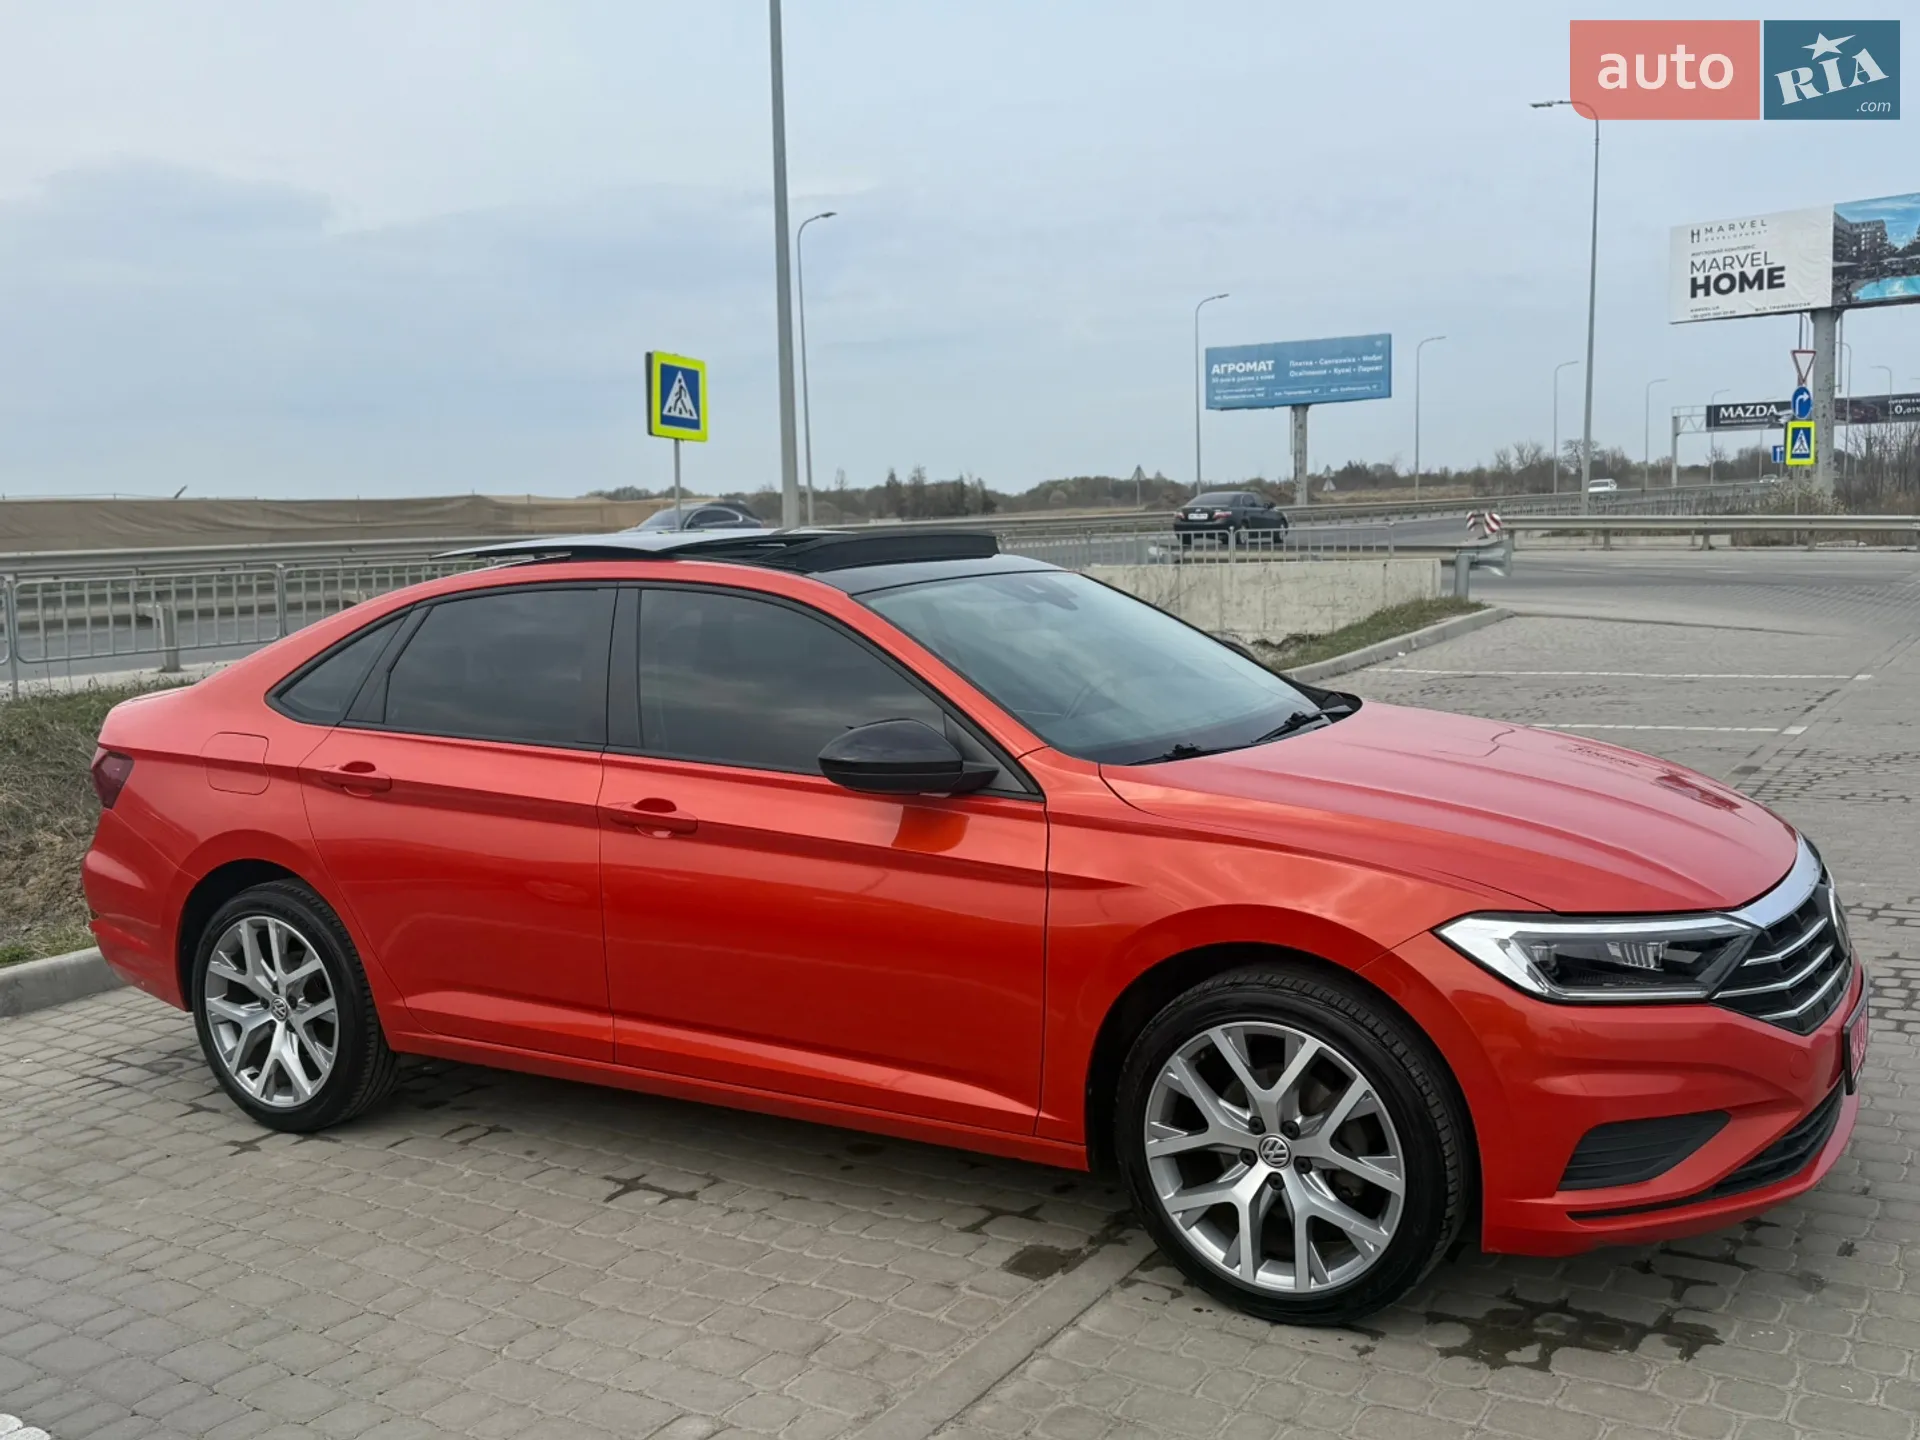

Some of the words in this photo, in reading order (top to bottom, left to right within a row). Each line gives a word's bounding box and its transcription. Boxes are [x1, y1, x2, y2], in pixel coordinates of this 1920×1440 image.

[1704, 219, 1767, 234] MARVEL
[1690, 251, 1775, 275] MARVEL
[1690, 265, 1786, 299] HOME
[1211, 359, 1275, 375] АГРОМАТ
[1719, 404, 1778, 419] MAZDA
